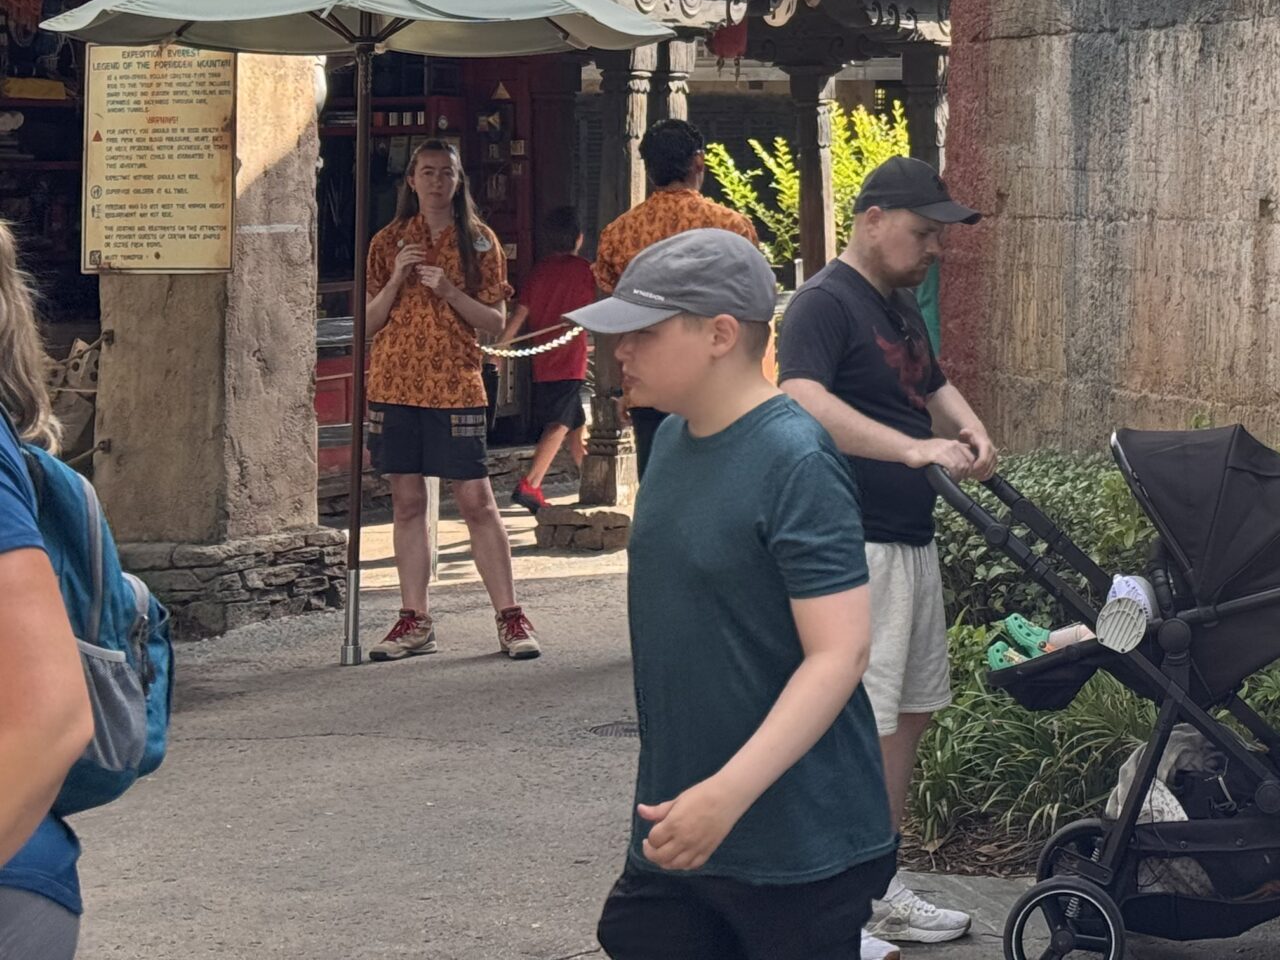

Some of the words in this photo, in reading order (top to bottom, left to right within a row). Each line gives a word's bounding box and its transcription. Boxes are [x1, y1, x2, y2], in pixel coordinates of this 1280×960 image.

[122, 49, 162, 59] EXPEDITION
[167, 49, 200, 58] EVEREST
[92, 62, 120, 71] LEGEND
[122, 62, 133, 71] OF
[136, 61, 150, 70] THE
